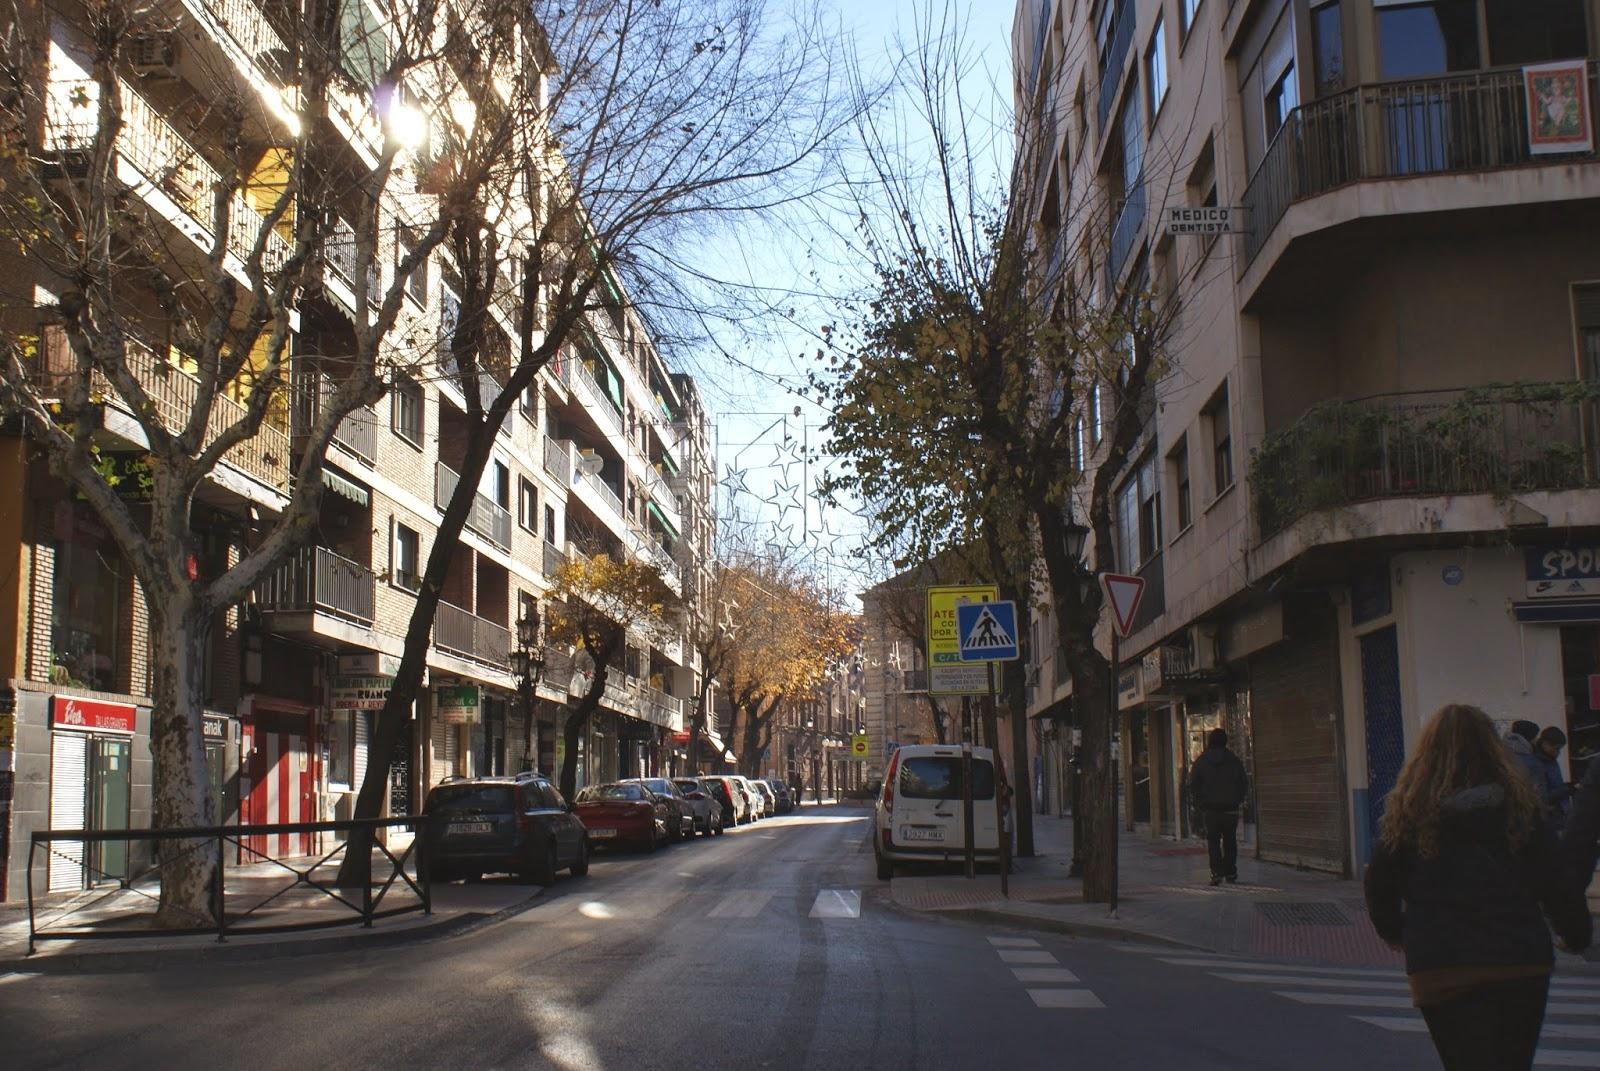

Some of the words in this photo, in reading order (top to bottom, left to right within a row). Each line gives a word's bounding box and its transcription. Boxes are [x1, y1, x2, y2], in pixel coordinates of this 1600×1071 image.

[1171, 209, 1228, 221] MEDICO
[1171, 223, 1231, 232] DENTISTA
[933, 610, 956, 619] ATE
[941, 620, 957, 628] CO
[203, 719, 222, 736] anak
